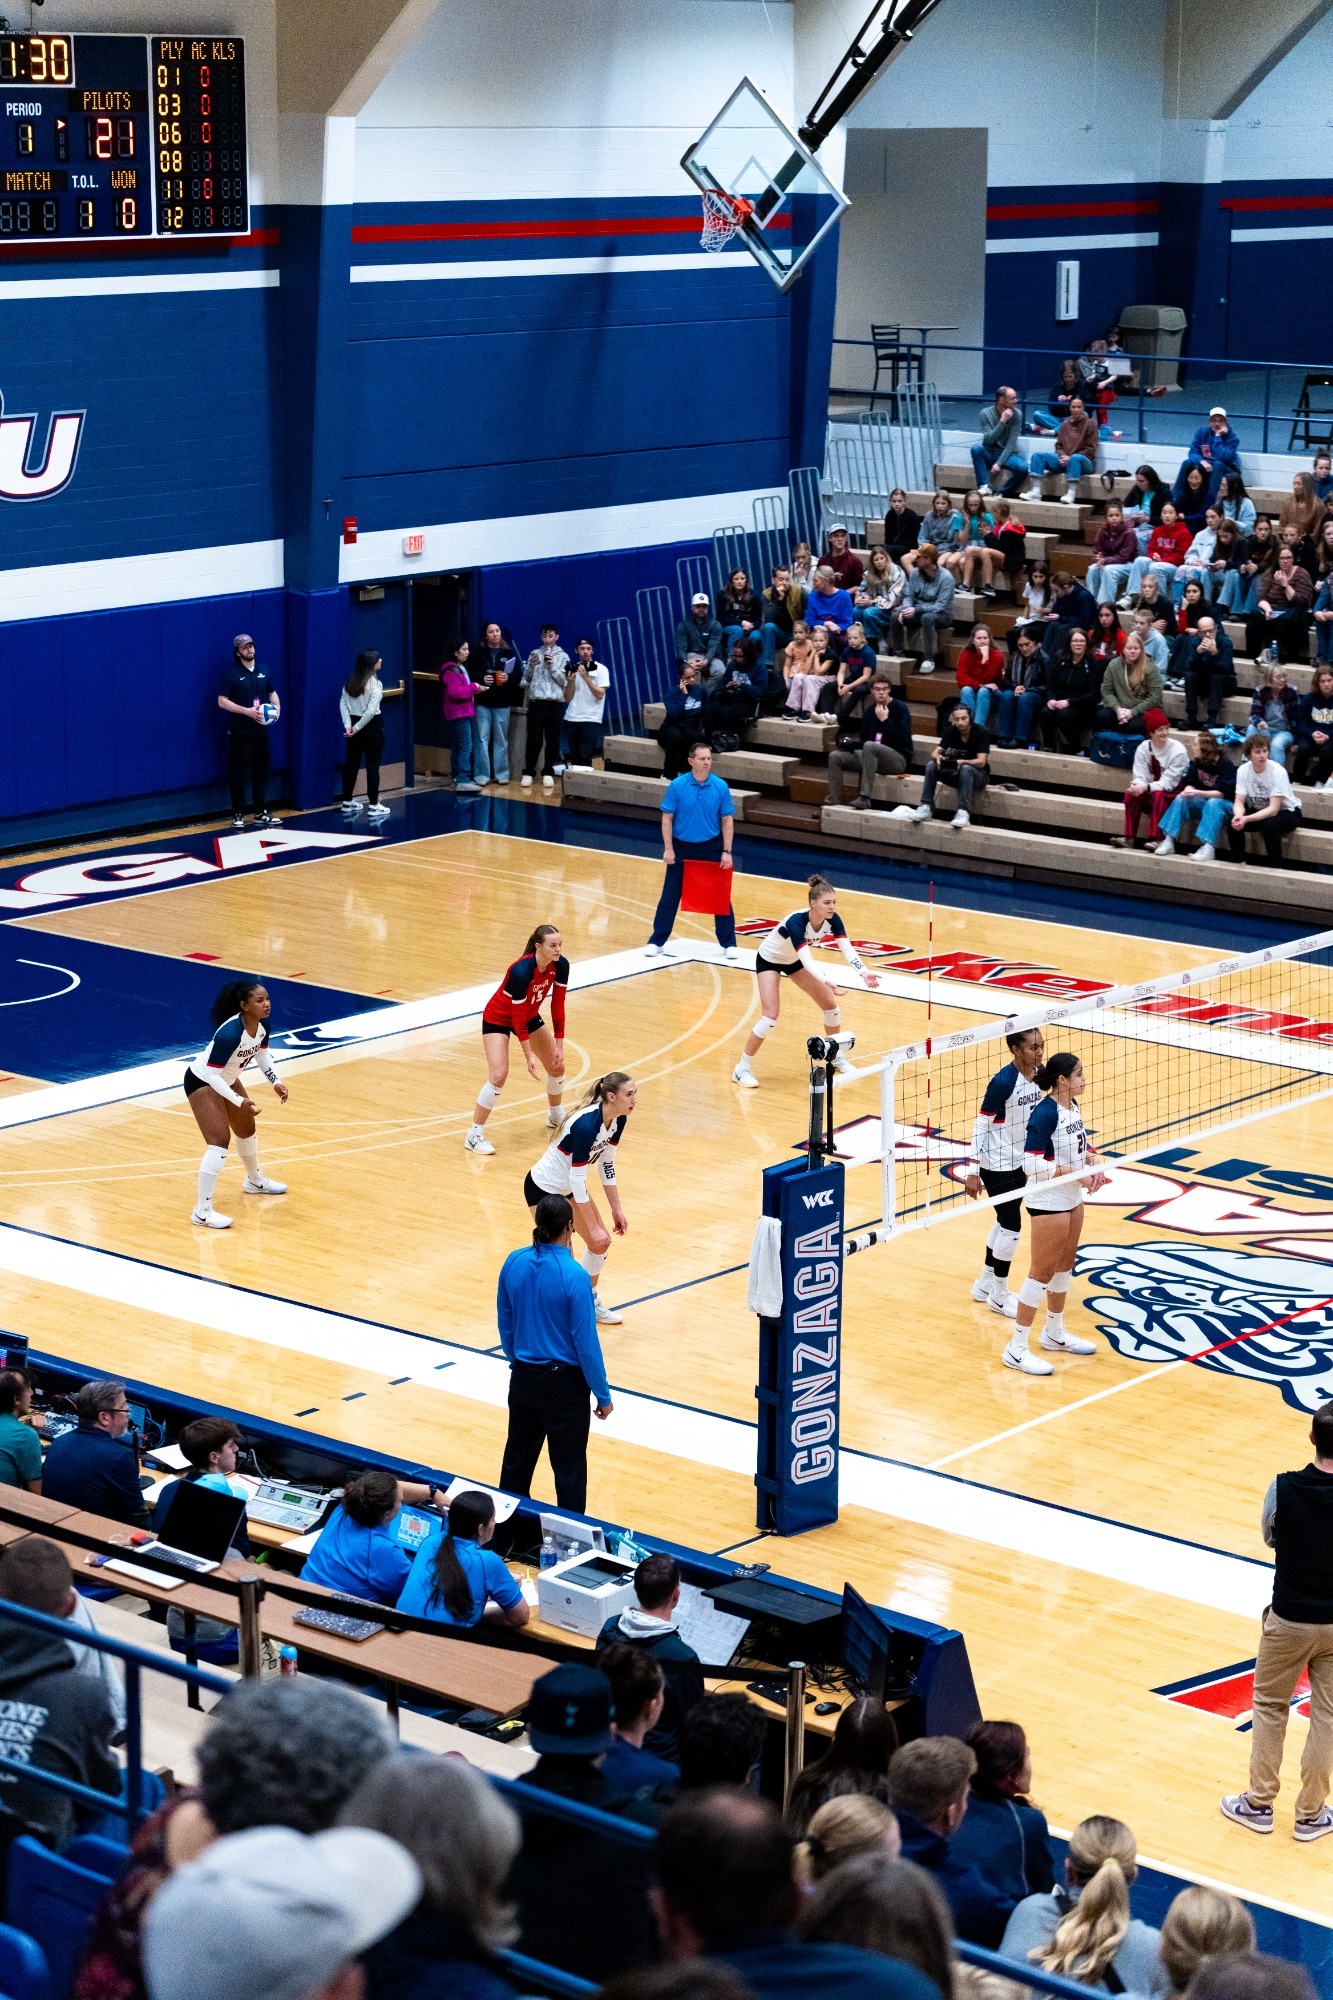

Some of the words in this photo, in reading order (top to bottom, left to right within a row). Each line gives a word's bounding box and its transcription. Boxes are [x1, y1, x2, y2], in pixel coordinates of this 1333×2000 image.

[11, 39, 69, 80] 1:30
[161, 41, 183, 60] PLY
[191, 41, 207, 60] AC
[212, 42, 236, 60] KLS
[157, 65, 180, 88] 01
[200, 65, 210, 88] 0
[6, 102, 42, 116] PERIOD
[83, 91, 131, 110] PILOTS
[158, 93, 181, 116] 03
[201, 93, 211, 116] 0
[27, 125, 33, 153] 1
[96, 118, 134, 158] 21
[159, 122, 181, 144] 06
[202, 122, 212, 144] 0
[160, 150, 182, 173] 08
[6, 171, 51, 191] MATCH
[72, 174, 99, 189] T.O.L.
[111, 170, 136, 189] WON
[166, 180, 183, 199] 11
[203, 178, 213, 199] 0
[88, 201, 93, 228] 1
[122, 198, 136, 229] 0
[167, 206, 184, 229] 12
[0, 409, 87, 502] U
[408, 534, 424, 552] EXIT
[603, 1161, 616, 1180] ZAGS
[802, 1188, 835, 1210] WCC
[790, 1220, 840, 1486] GONZAGA
